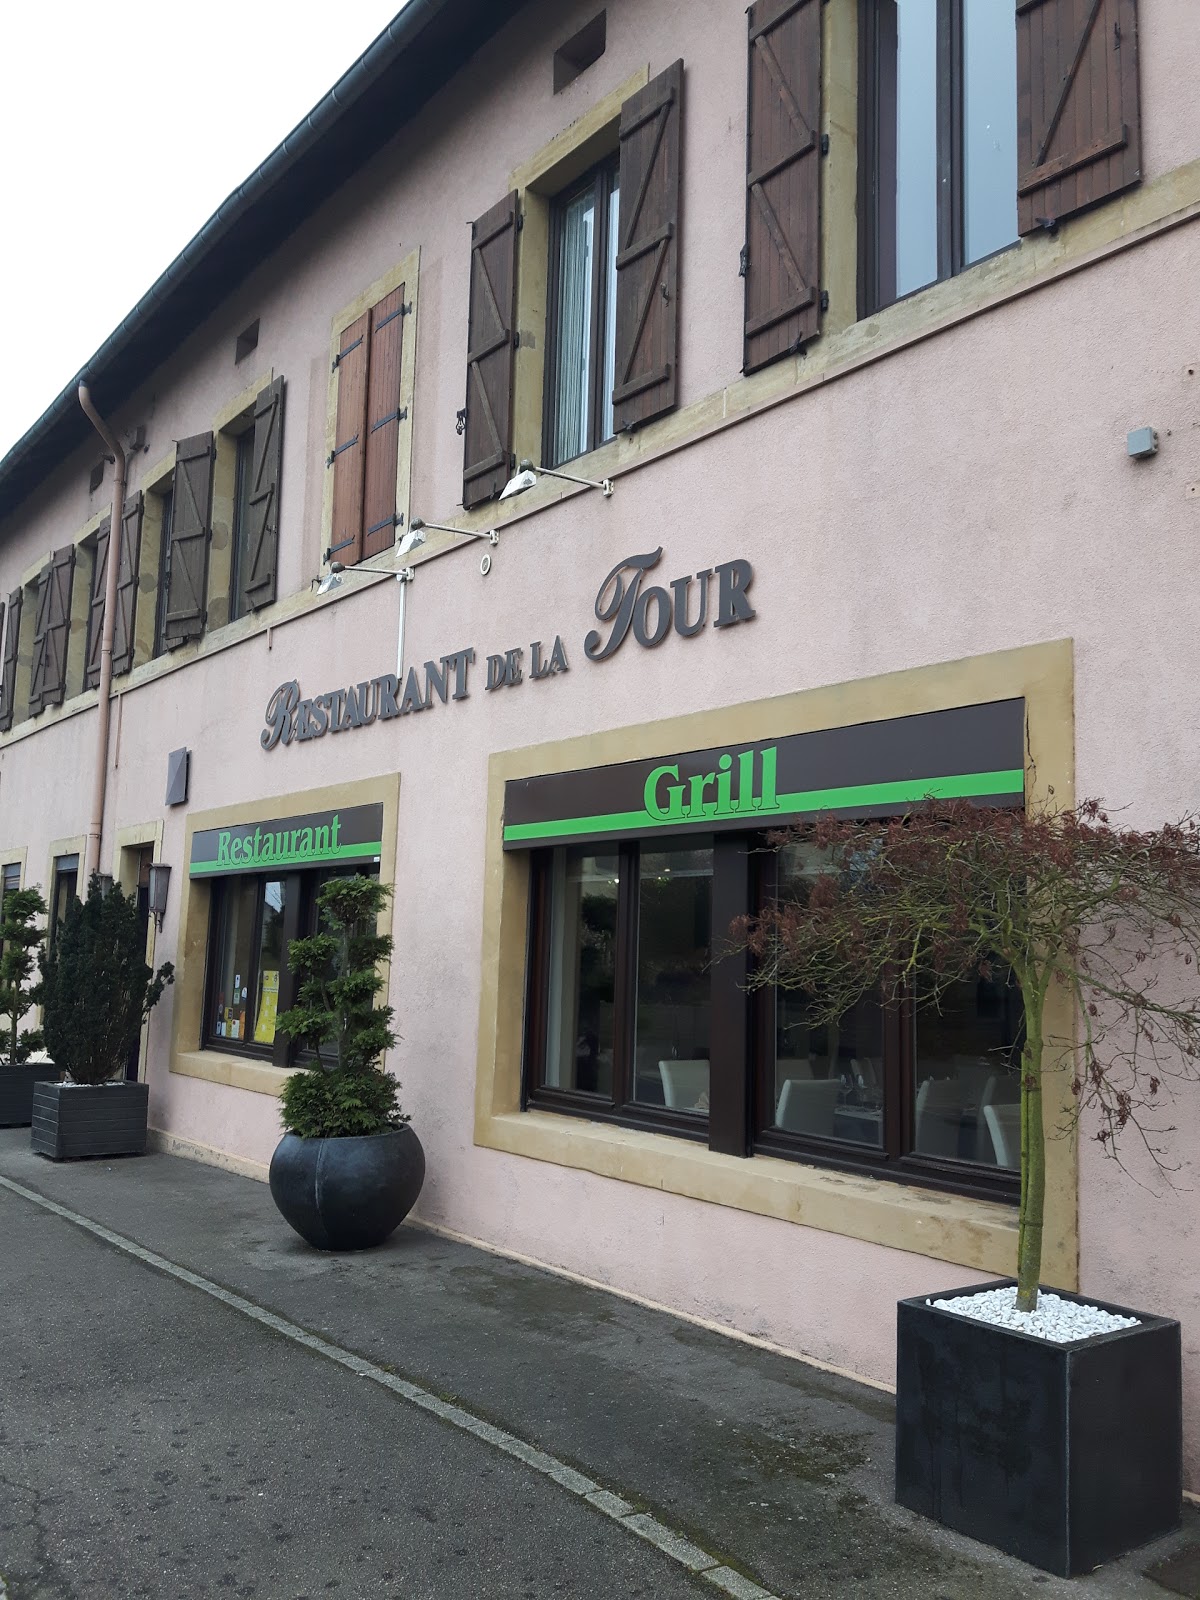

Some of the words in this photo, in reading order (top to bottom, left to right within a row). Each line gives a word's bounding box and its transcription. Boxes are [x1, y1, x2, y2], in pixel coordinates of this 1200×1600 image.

[260, 647, 475, 751] RESTAURANT
[485, 648, 523, 691] DE
[529, 635, 568, 680] LA
[584, 546, 757, 661] TOUR
[643, 746, 780, 821] Grill
[216, 814, 341, 867] Restaurant
